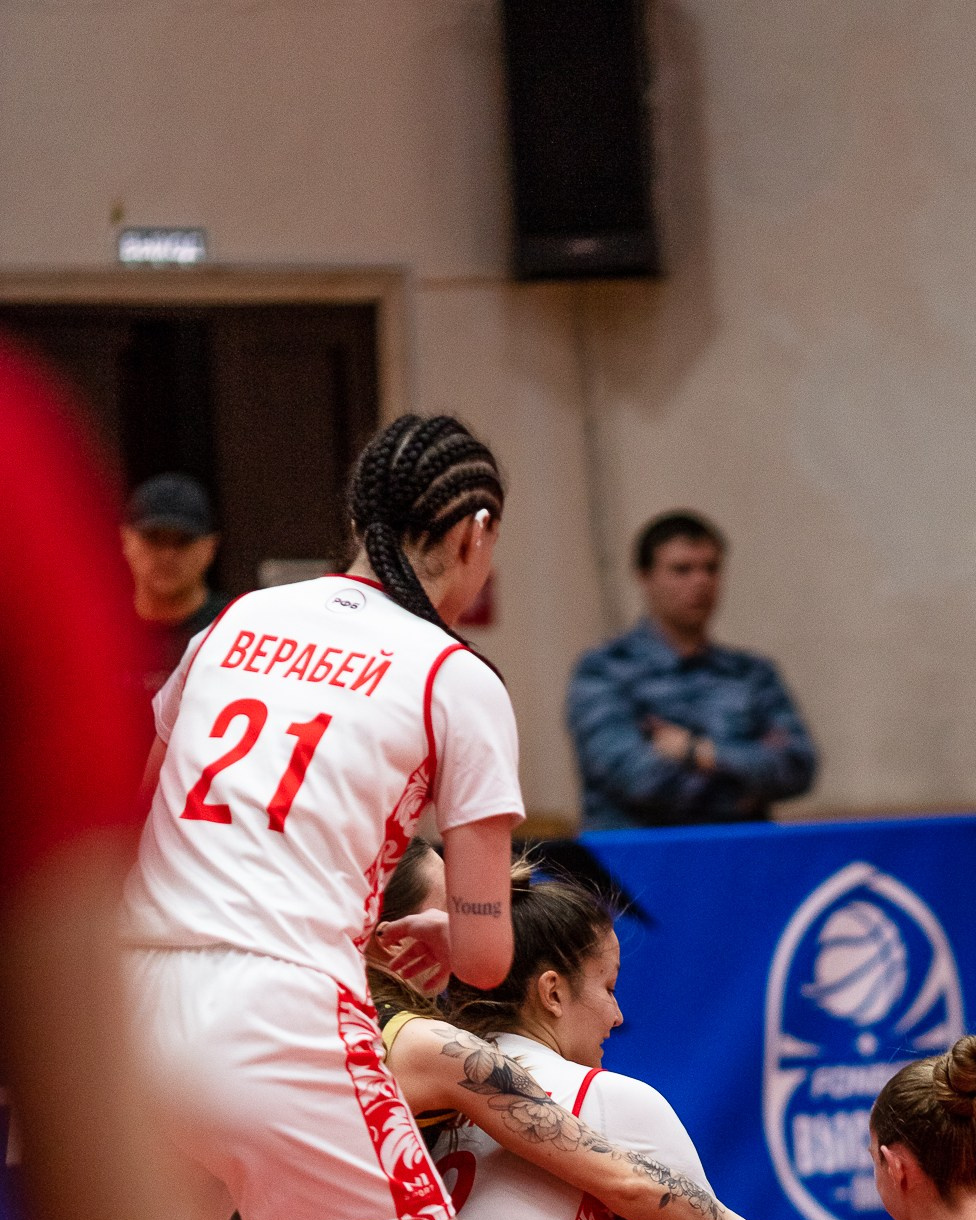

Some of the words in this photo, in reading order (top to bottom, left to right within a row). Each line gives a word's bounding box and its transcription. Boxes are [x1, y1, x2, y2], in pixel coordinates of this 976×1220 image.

[220, 630, 394, 697] ВЕРАБЕЙ
[179, 698, 333, 834] 21
[451, 896, 501, 918] Young
